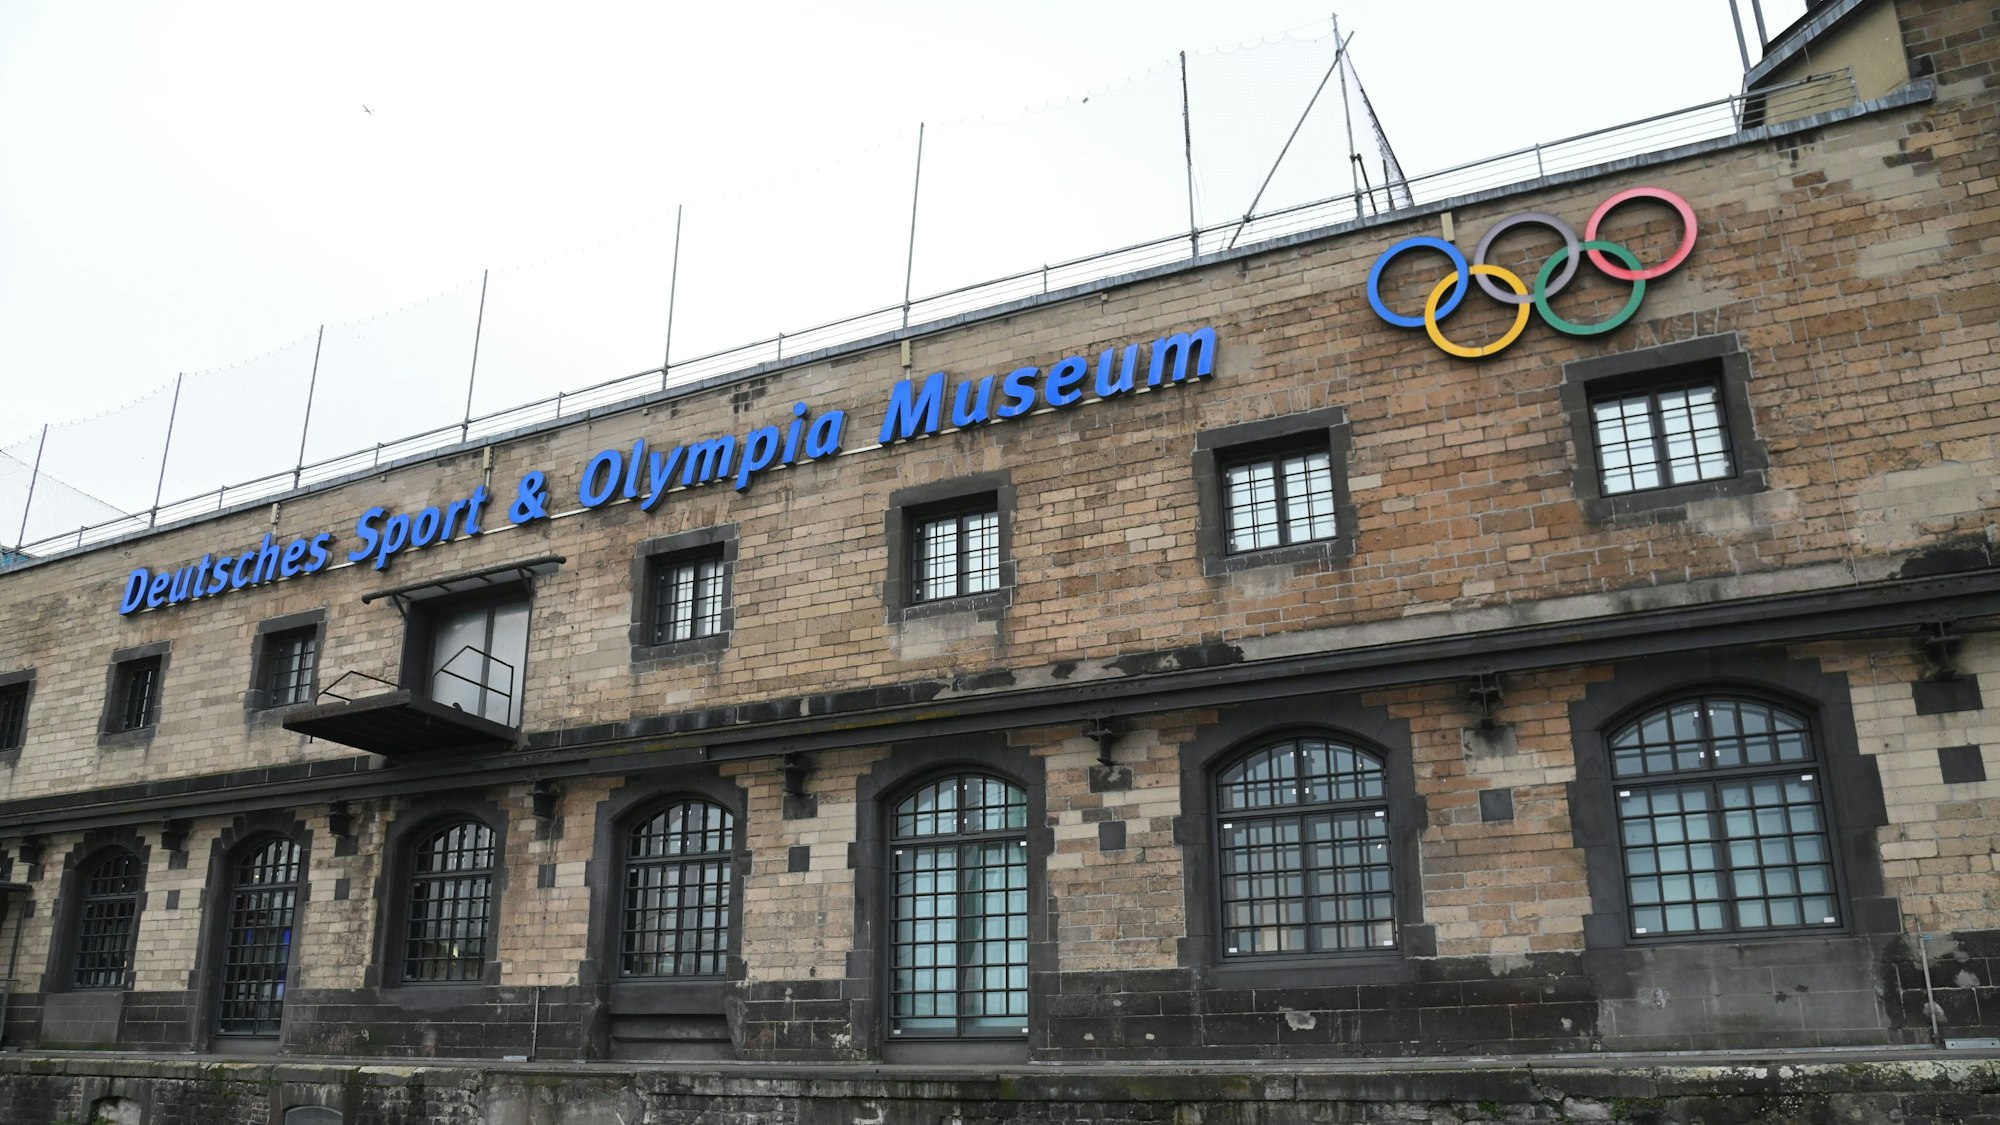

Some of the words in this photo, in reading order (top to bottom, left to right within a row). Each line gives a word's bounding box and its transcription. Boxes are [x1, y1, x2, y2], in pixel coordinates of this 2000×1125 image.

[120, 533, 333, 615] Deutsches
[349, 484, 490, 570] Sport
[509, 470, 549, 525] &
[580, 400, 846, 511] Olympia
[879, 327, 1218, 444] Museum
